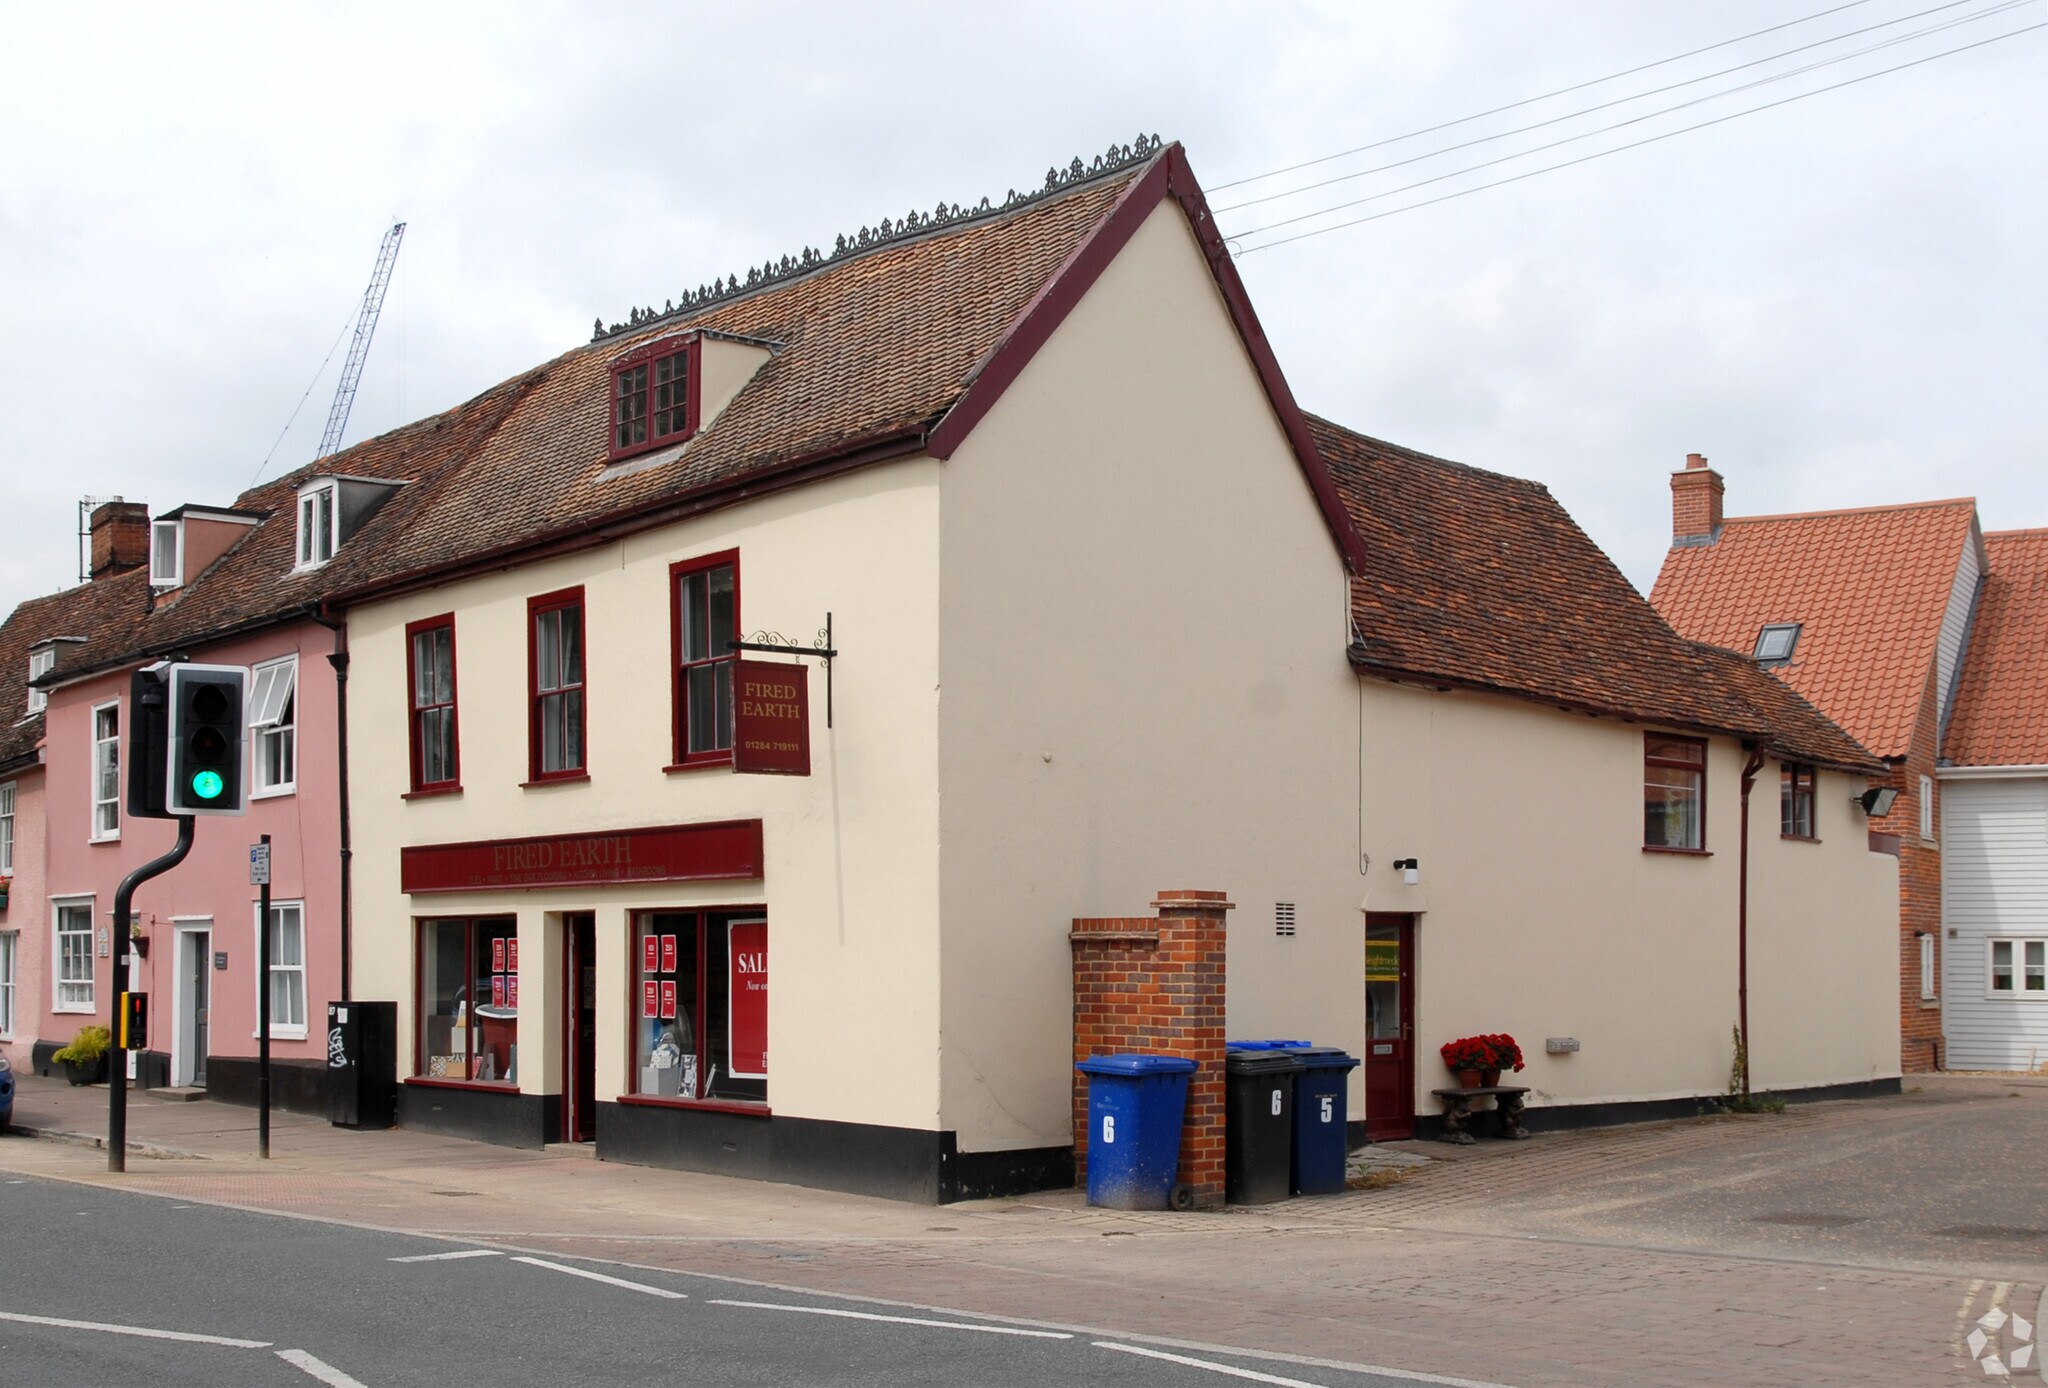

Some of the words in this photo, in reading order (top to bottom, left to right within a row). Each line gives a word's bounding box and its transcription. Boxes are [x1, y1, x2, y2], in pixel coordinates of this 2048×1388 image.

[745, 683, 796, 699] FIRED
[742, 702, 800, 719] EARTH
[745, 741, 770, 750] 01284
[773, 742, 799, 751] 719111
[493, 842, 553, 871] FIRED
[558, 836, 632, 867] EARTH
[738, 952, 768, 973] SAL
[746, 980, 760, 990] Now
[1271, 1089, 1281, 1115] 6
[1320, 1097, 1332, 1123] 5
[1103, 1116, 1114, 1143] 6
